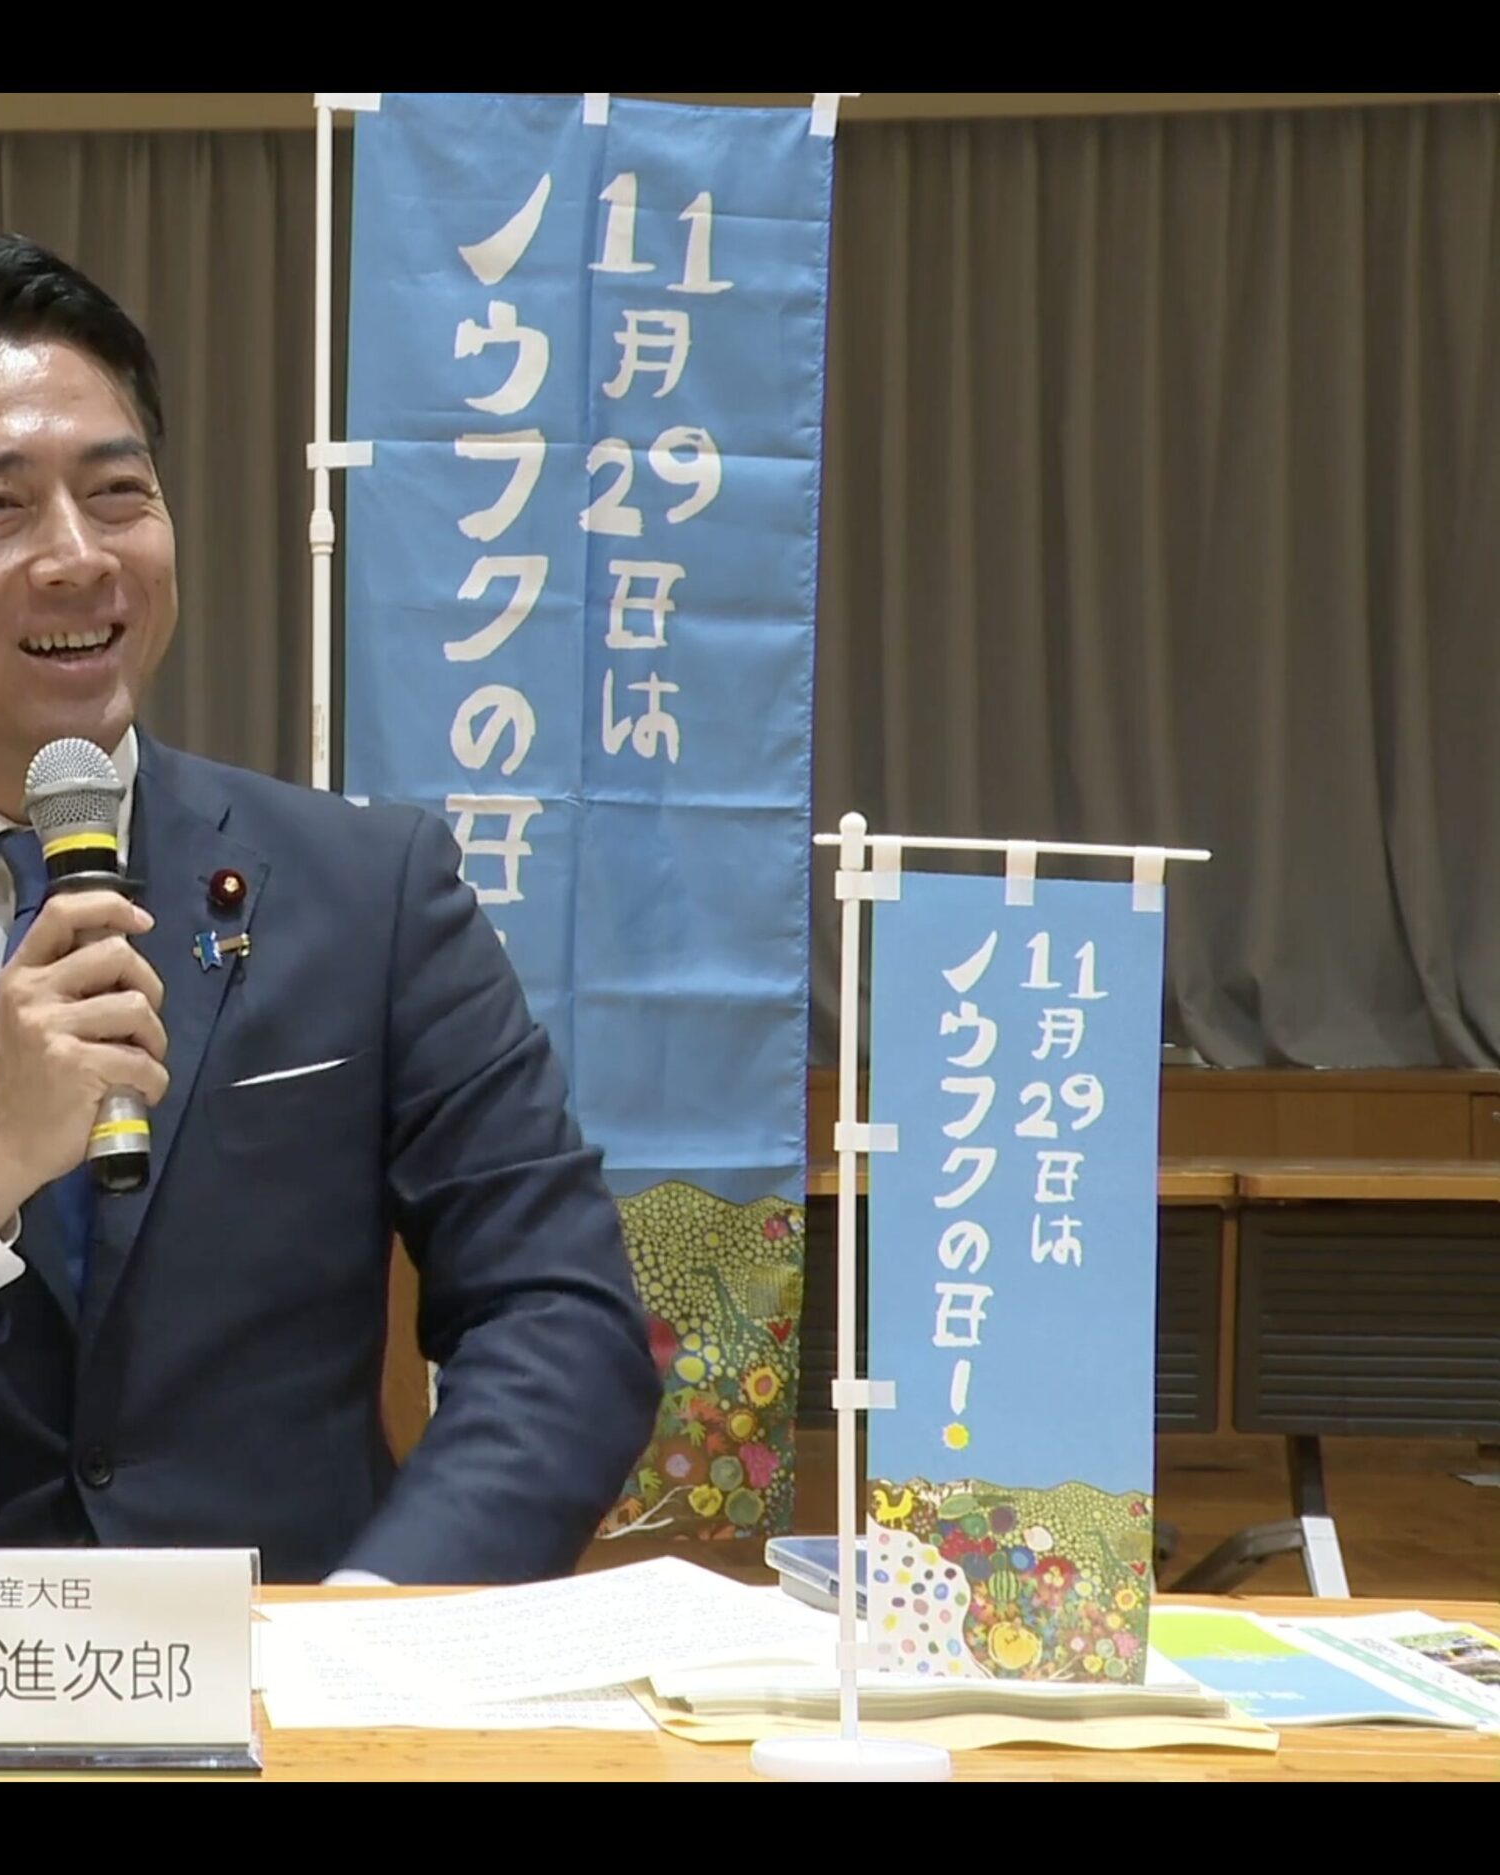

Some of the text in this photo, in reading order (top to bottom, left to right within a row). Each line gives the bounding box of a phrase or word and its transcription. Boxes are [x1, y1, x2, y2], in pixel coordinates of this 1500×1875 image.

[443, 173, 551, 946] ノウフクの日
[579, 171, 734, 763] 11月29日は
[1014, 930, 1109, 1268] 11月29日は
